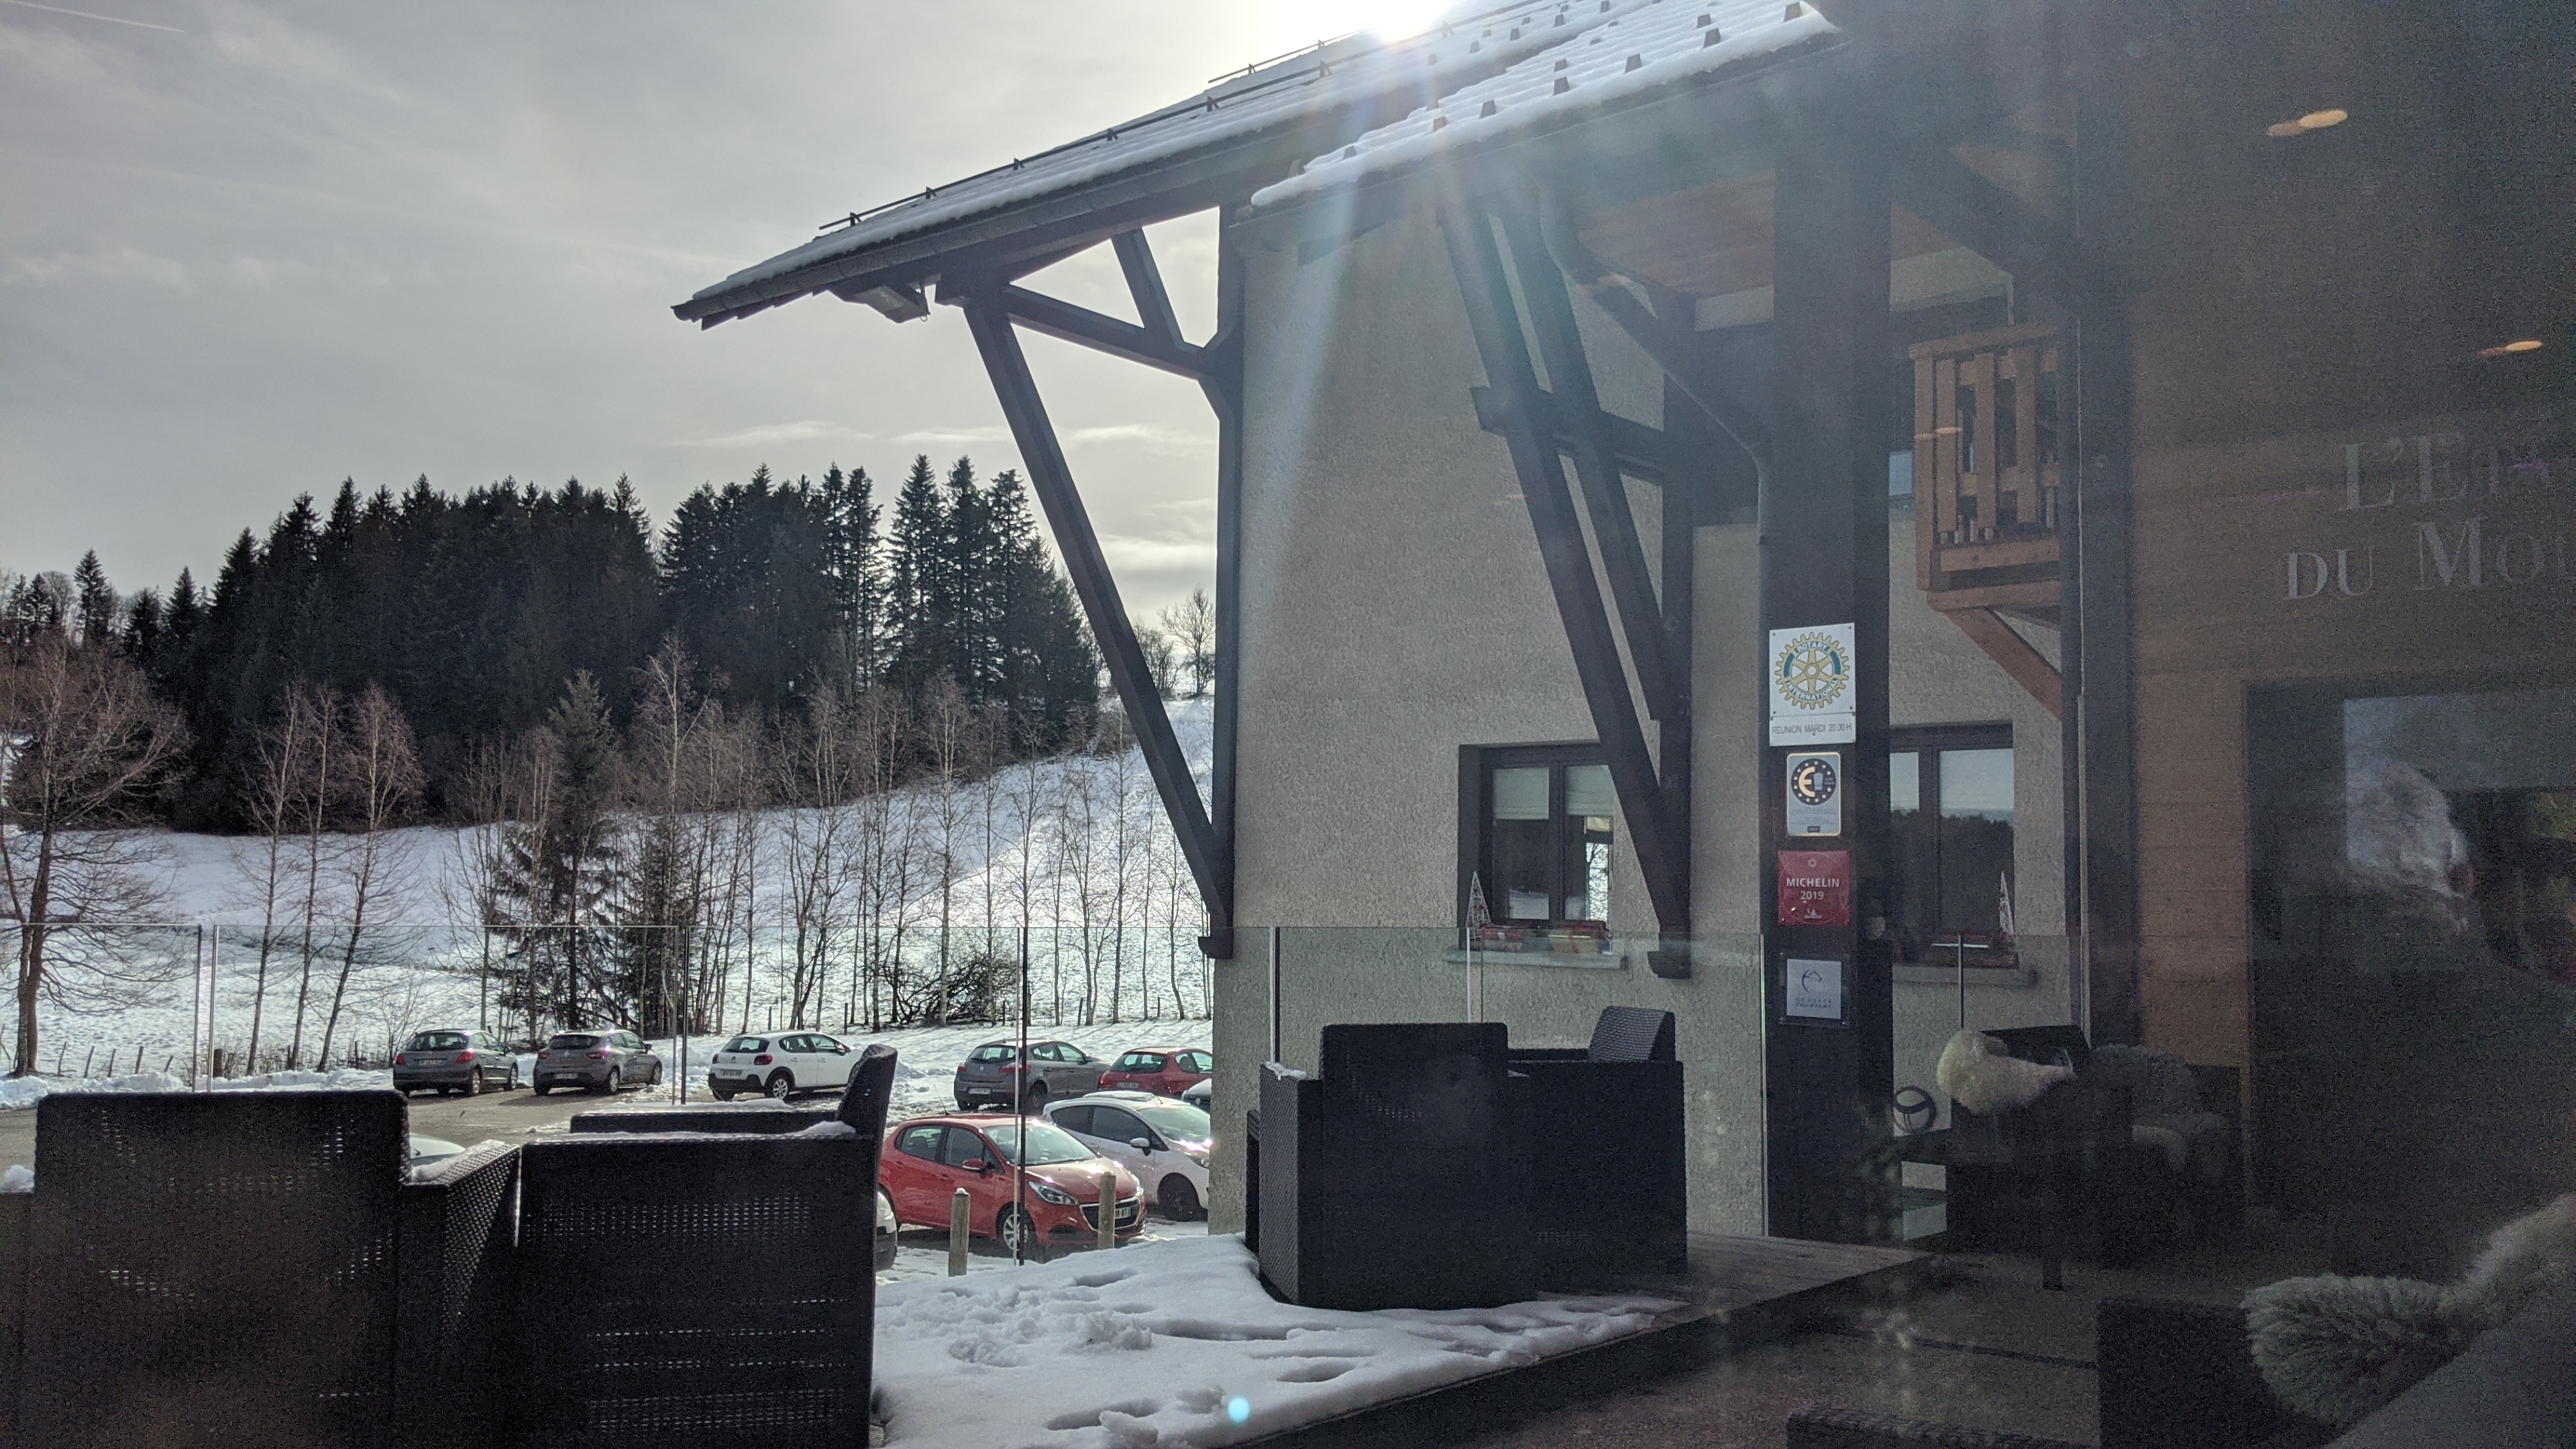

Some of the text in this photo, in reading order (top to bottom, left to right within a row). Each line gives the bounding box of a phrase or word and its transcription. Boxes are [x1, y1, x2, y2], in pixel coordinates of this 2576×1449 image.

[2282, 546, 2375, 600] DU
[1796, 641, 1828, 653] ROTARY
[1785, 678, 1838, 702] INTERNATIONAL
[1771, 725, 1802, 735] REUNION
[1805, 724, 1825, 733] MARDI
[1786, 877, 1839, 888] MICHELIN
[1801, 891, 1824, 900] 2019
